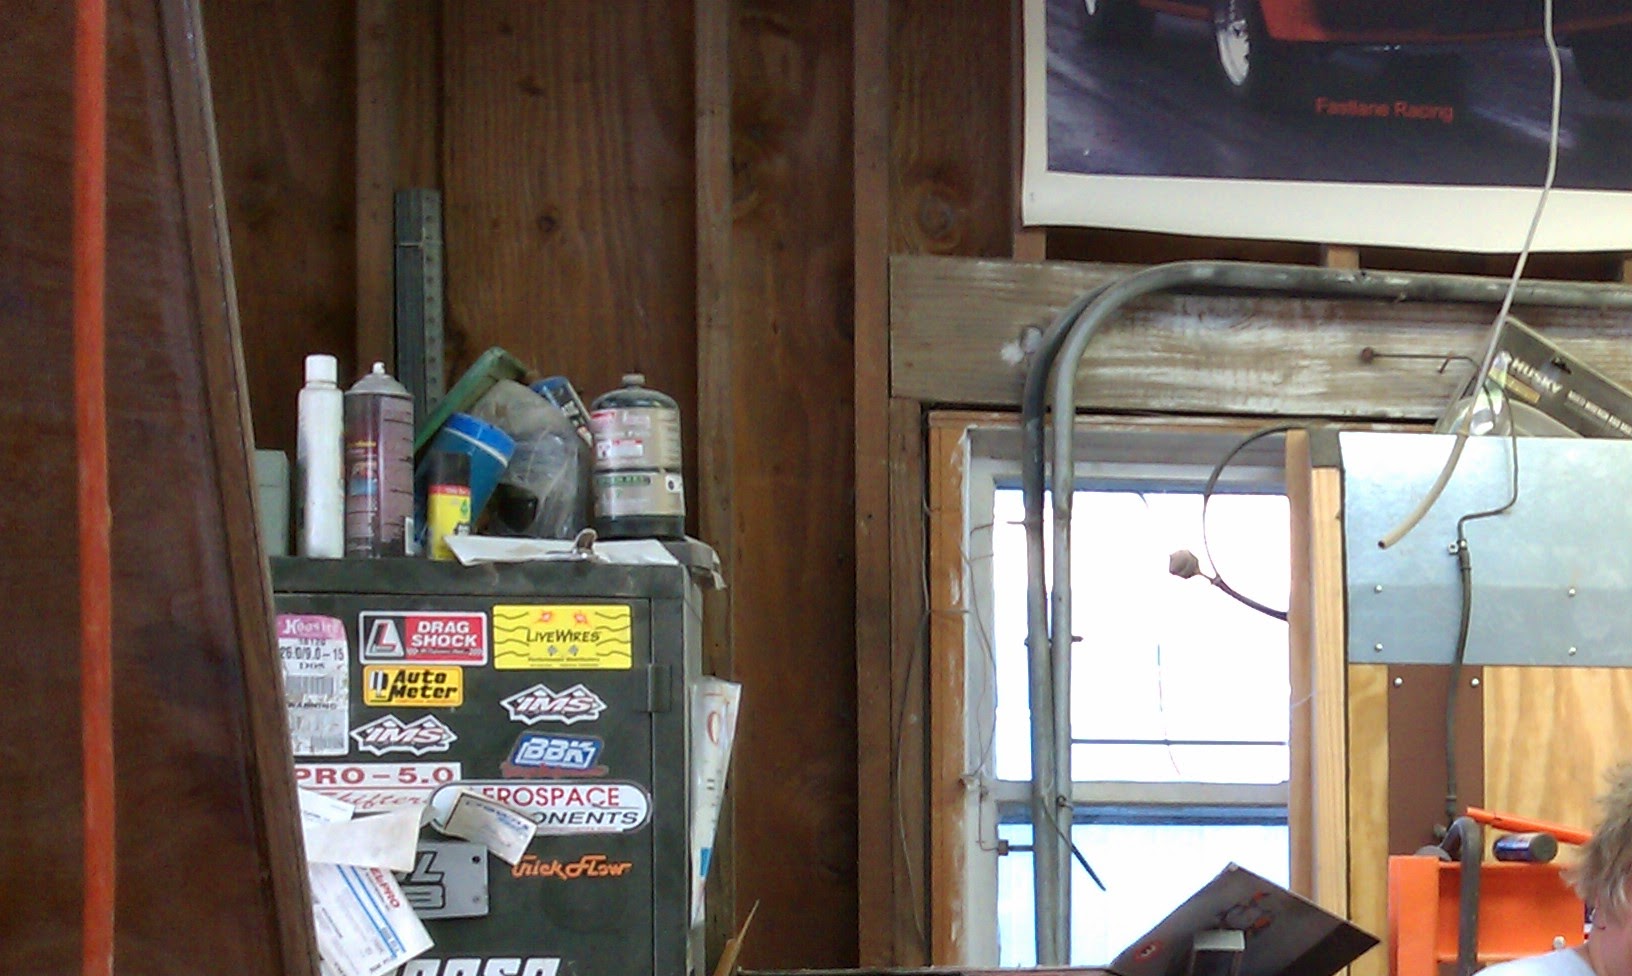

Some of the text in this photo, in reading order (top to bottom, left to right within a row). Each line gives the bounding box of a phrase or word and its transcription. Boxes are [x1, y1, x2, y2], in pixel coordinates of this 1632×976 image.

[1315, 97, 1453, 123] Fastlane Racing
[1511, 357, 1563, 394] HUSKY
[417, 620, 469, 635] DRAG
[411, 634, 477, 648] SHOCK
[394, 670, 446, 685] Auto
[388, 684, 458, 700] Meter
[522, 737, 592, 764] BBK
[481, 787, 620, 807] EROSPACE
